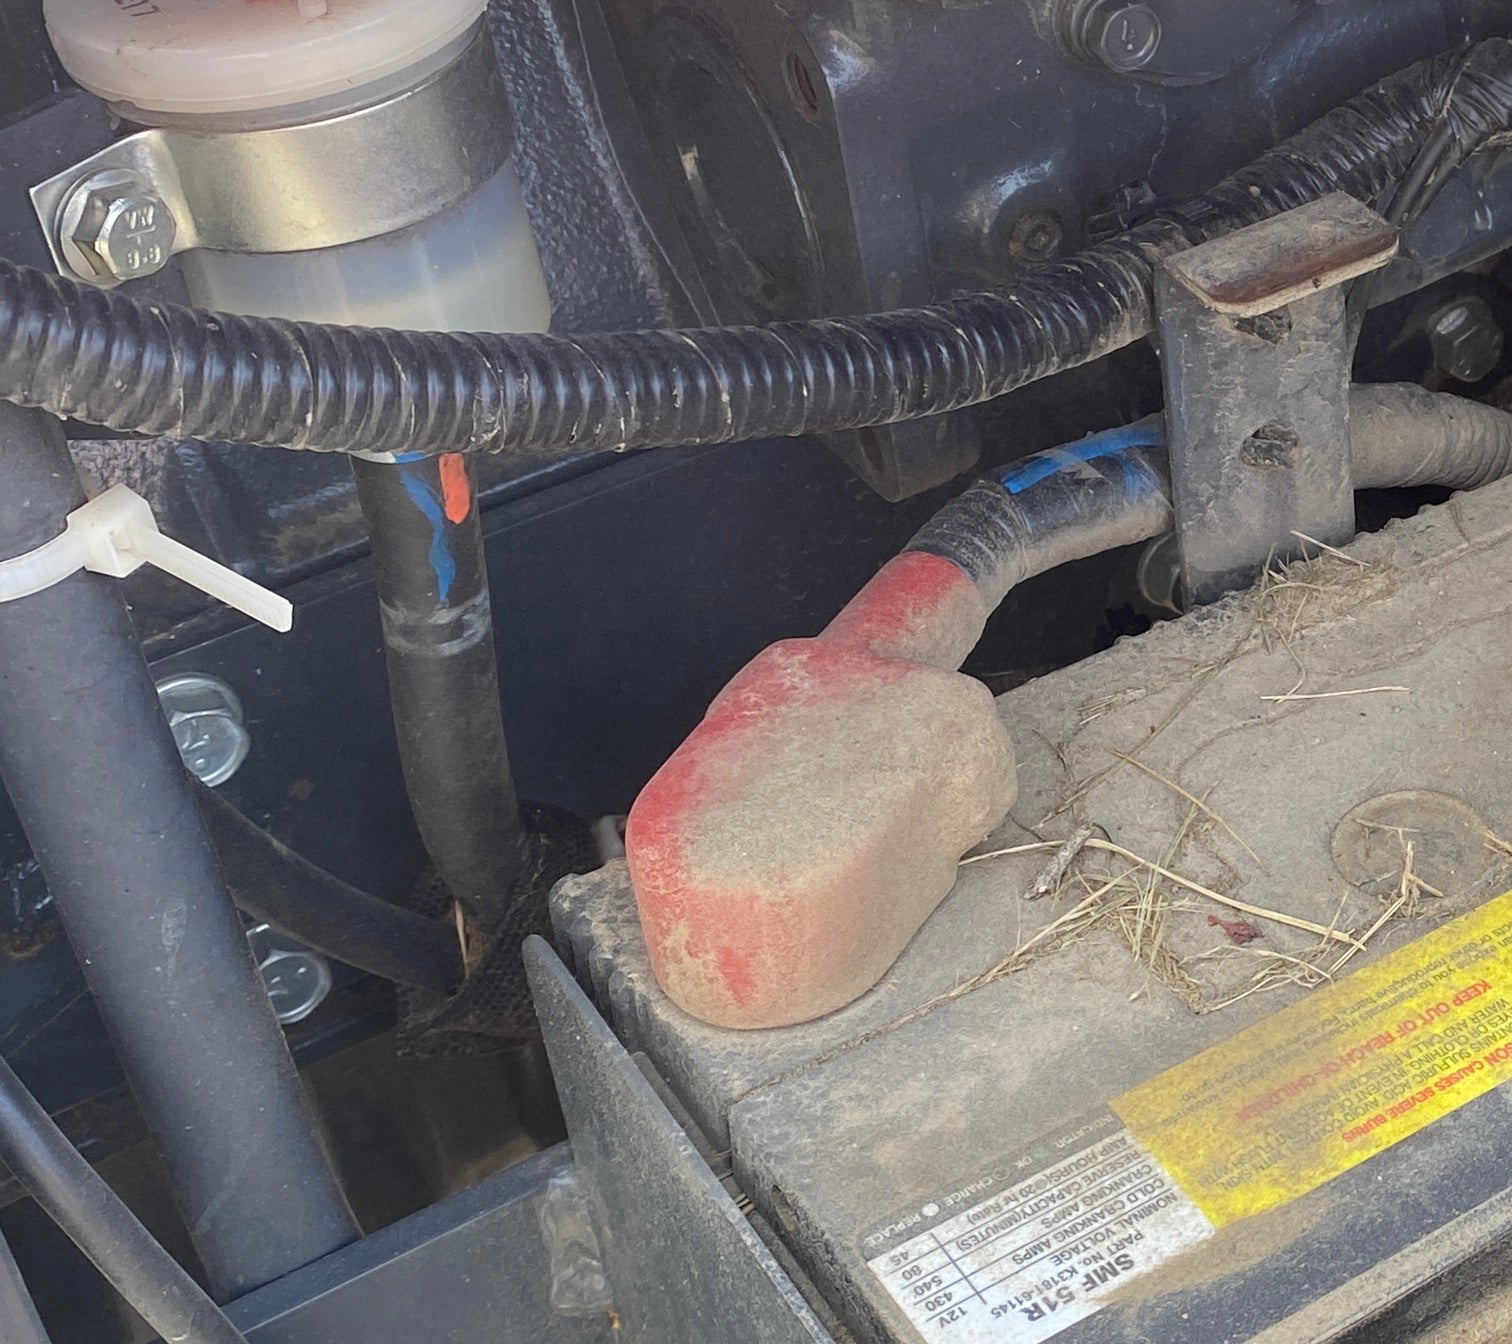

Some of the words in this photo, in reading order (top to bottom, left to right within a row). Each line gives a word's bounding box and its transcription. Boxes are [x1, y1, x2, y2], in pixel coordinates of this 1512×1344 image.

[1477, 933, 1493, 944] or
[1418, 979, 1433, 990] to
[1429, 965, 1456, 982] you
[1447, 978, 1492, 1007] KEEP
[1414, 1000, 1452, 1025] OUT
[1466, 996, 1510, 1024] WATER
[1392, 1018, 1419, 1037] OF
[1441, 1018, 1471, 1038] AND
[1467, 1023, 1490, 1039] OR
[1338, 1030, 1396, 1066] REACH
[1399, 1049, 1415, 1061] A
[1411, 1032, 1445, 1054] CALL
[1318, 1060, 1342, 1077] OF
[1337, 1055, 1404, 1095] PHYSICIAN
[1390, 1067, 1409, 1081] IN
[1410, 1047, 1472, 1085] SULFURIC
[1431, 1058, 1486, 1092] CAUSES
[1353, 1075, 1394, 1101] EVENT
[1332, 1097, 1355, 1113] OF
[1341, 1096, 1382, 1123] AVOID
[1384, 1086, 1436, 1118] SEVERE
[1052, 1111, 1113, 1148] INDICATOR
[1340, 1113, 1387, 1143] BURNS
[1095, 1134, 1128, 1156] AMP
[1012, 1154, 1033, 1169] OK
[1080, 1148, 1141, 1185] RESERVE
[941, 1174, 993, 1206] CHARGE
[1079, 1162, 1154, 1207] CRANKING
[1123, 1176, 1166, 1203] COLD
[963, 1199, 1003, 1225] Rate)
[999, 1191, 1020, 1207] hr
[1113, 1191, 1178, 1230] NOMINAL
[1038, 1200, 1082, 1229] AMPS
[1051, 1197, 1126, 1243] CRANKING
[864, 1211, 922, 1247] REPLACE
[1102, 1228, 1144, 1255] PART
[888, 1249, 910, 1266] 45
[1010, 1237, 1054, 1266] AMPS
[1048, 1225, 1115, 1266] VOLTAGE
[899, 1263, 922, 1281] 80
[1075, 1251, 1137, 1292] SMF
[1076, 1250, 1104, 1270] No.
[910, 1274, 943, 1296] 540
[988, 1264, 1078, 1318] K3181-61145
[923, 1289, 955, 1312] 430
[1019, 1283, 1077, 1324] 51R
[934, 1304, 967, 1327] 12V
